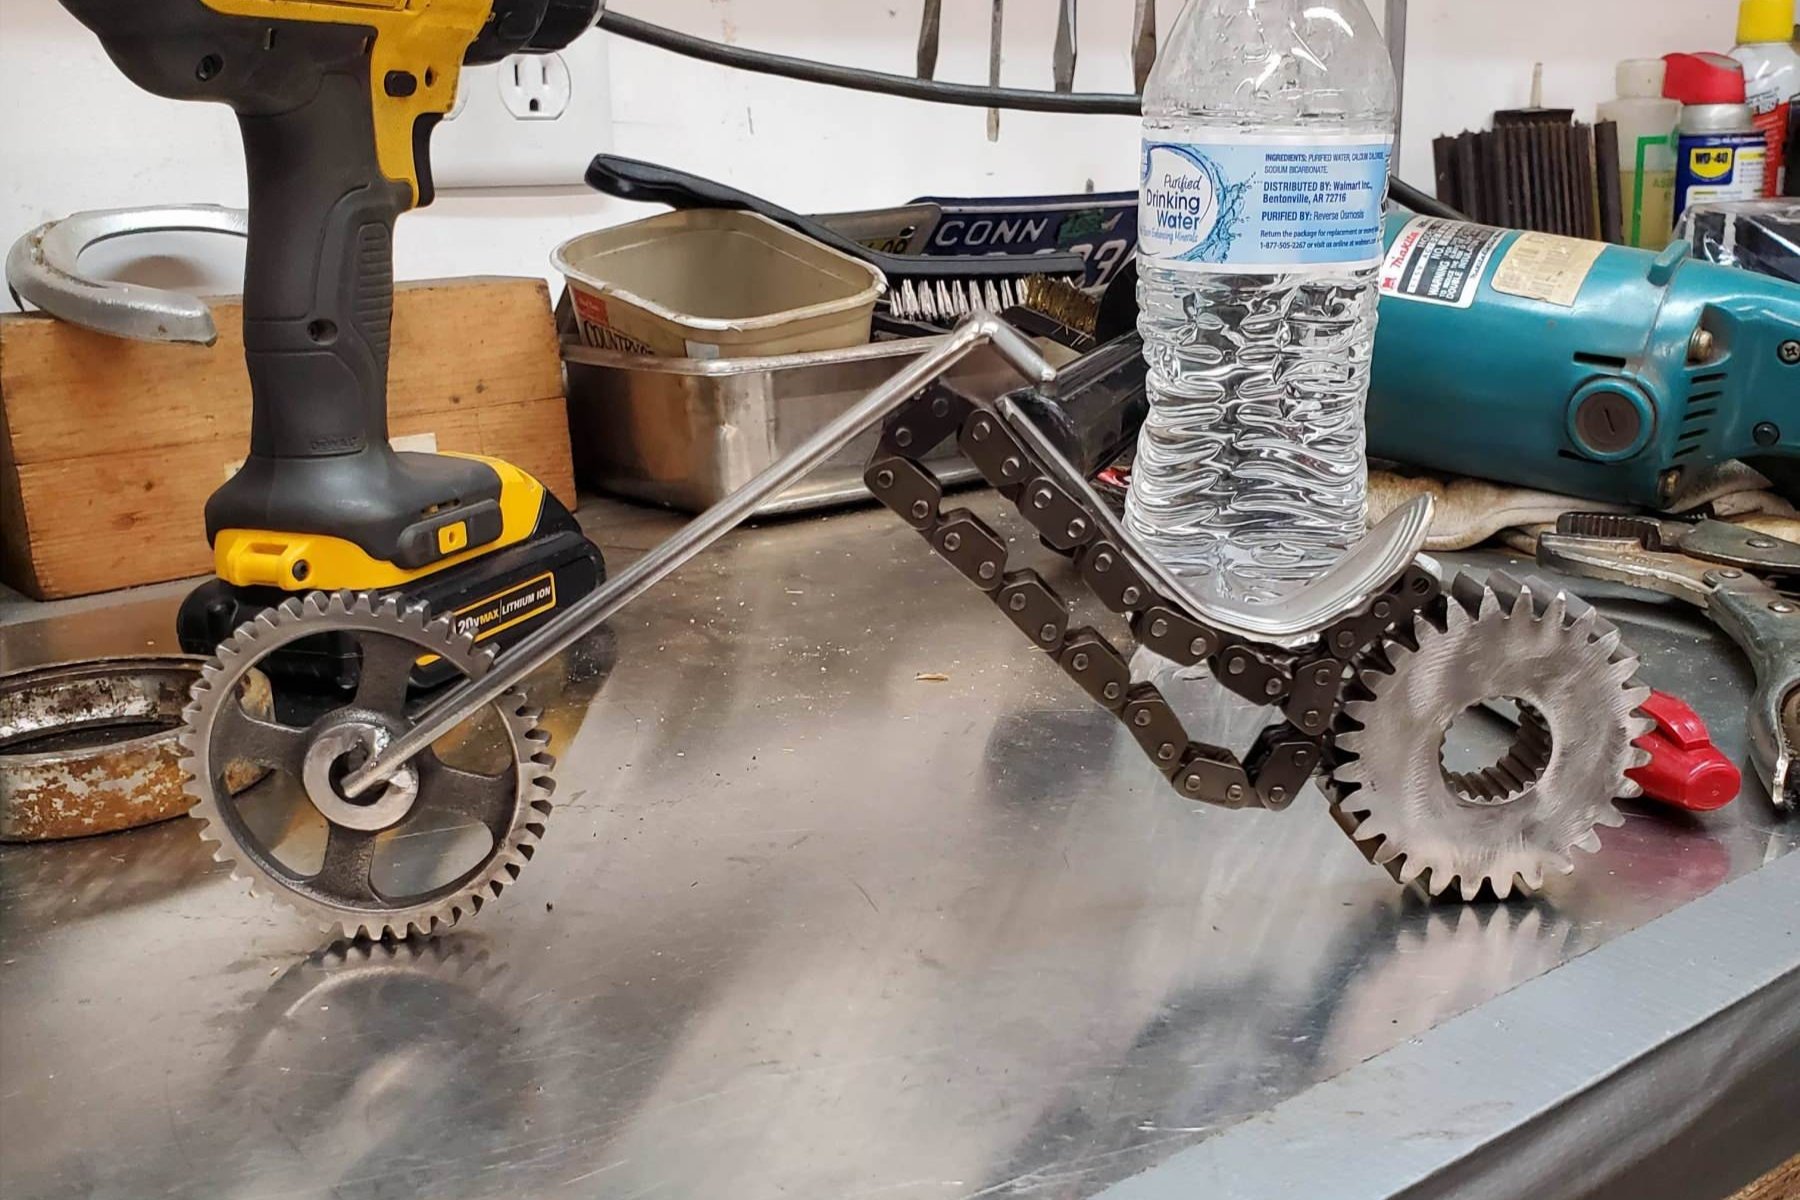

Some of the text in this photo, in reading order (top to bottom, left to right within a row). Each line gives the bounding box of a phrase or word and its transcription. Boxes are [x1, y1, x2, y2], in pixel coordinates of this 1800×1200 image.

[1265, 153, 1307, 163] INGREDIENTS:
[1308, 153, 1332, 162] PURIFIED
[1696, 152, 1729, 165] WD-40
[1264, 165, 1288, 174] SODIUM
[1164, 172, 1203, 193] Purified
[1263, 181, 1318, 192] DISTRIBUTED
[1320, 181, 1332, 192] BY:
[1333, 180, 1360, 191] Walmart
[1146, 188, 1201, 215] Drinking
[1262, 193, 1347, 205] Bentonville, AR 72716
[1156, 209, 1200, 231] Water
[1261, 209, 1365, 221] PURIFIED BY: Reverse Osmosis
[934, 217, 1048, 247] CONN
[1260, 229, 1281, 238] Return
[1282, 229, 1293, 238] the
[1294, 229, 1317, 239] package
[1318, 228, 1326, 237] for
[1326, 228, 1358, 237] replacement
[1314, 241, 1325, 249] visit
[1333, 240, 1348, 248] online
[1427, 259, 1450, 297] WARNING
[1445, 271, 1463, 300] DOUBLE
[501, 586, 551, 616] LITHIUM ION
[480, 608, 500, 625] MAX
